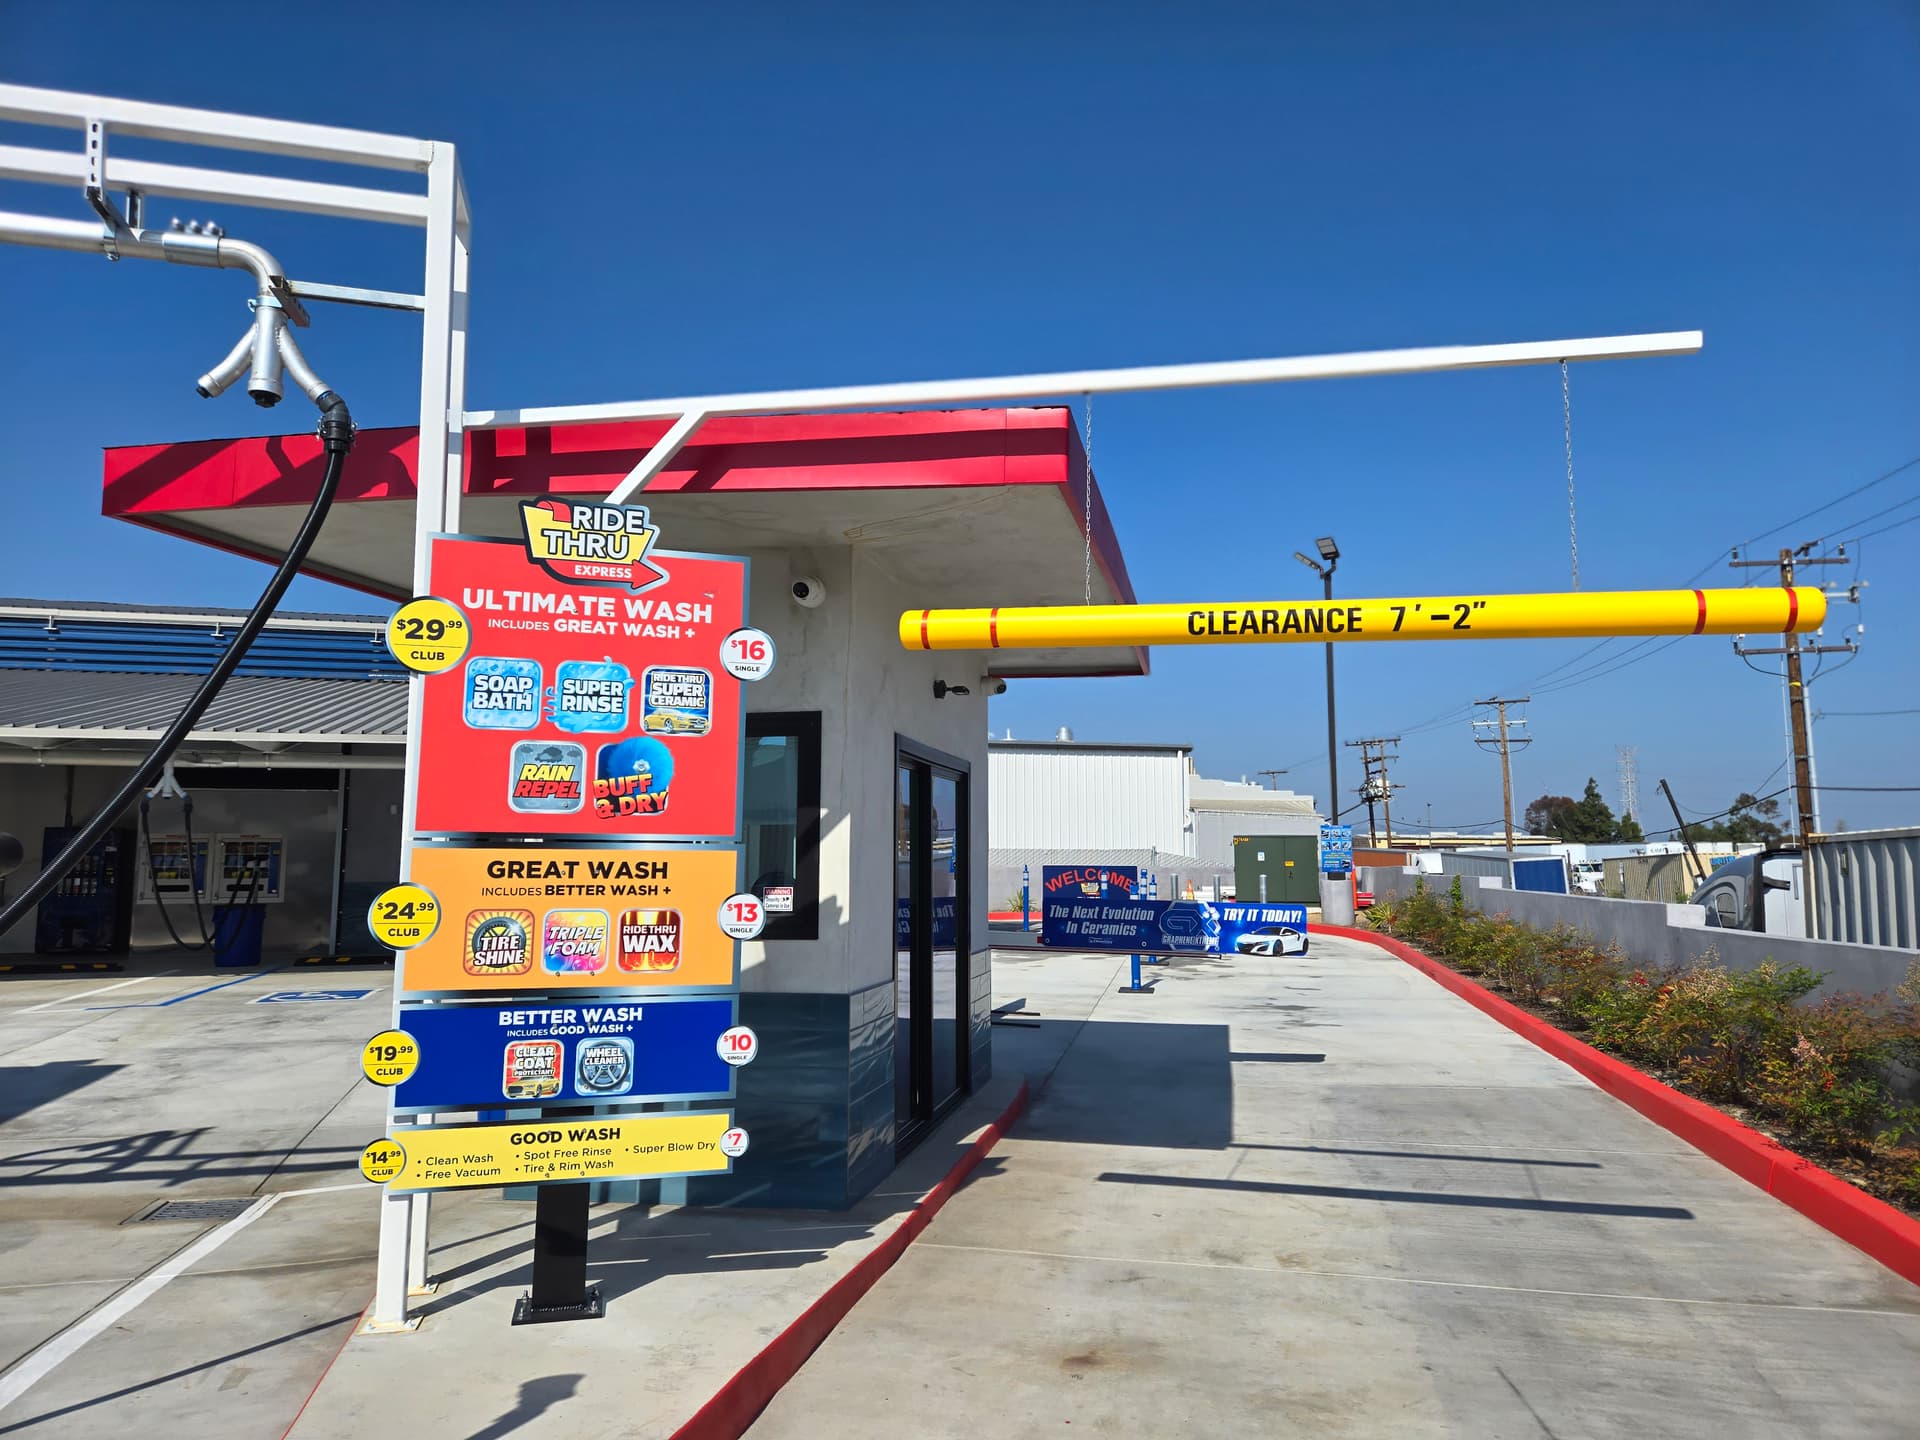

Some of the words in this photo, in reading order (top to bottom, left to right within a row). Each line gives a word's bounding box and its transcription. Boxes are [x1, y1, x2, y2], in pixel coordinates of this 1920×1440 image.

[572, 506, 644, 534] RIDE
[543, 530, 629, 559] THRU
[574, 565, 632, 579] EXPRESS
[463, 588, 616, 617] ULTIMATE
[623, 598, 713, 624] WASH
[488, 618, 550, 632] INCLUDES
[554, 619, 618, 635] GREAT
[622, 623, 680, 639] WASH
[1188, 606, 1363, 636] CLEARANCE
[397, 618, 463, 641] $29.99
[410, 651, 445, 661] CLUB
[731, 639, 766, 660] $16
[474, 674, 533, 693] SOAP
[562, 678, 624, 696] SUPER
[652, 682, 703, 697] SUPER
[473, 692, 533, 711] BATH
[561, 695, 624, 713] RINSE
[651, 695, 704, 707] CERAMIC
[519, 764, 574, 781] RAIN
[513, 780, 580, 798] REPEL
[592, 774, 652, 799] BUFF
[619, 791, 668, 815] DRY
[487, 860, 580, 879] GREAT
[587, 861, 668, 879] WASH
[481, 887, 542, 896] INCLUDES
[544, 885, 605, 896] BETTER
[610, 885, 658, 896] WASH
[377, 902, 435, 919] $24.99
[727, 903, 758, 922] $13
[1049, 905, 1069, 918] The
[1072, 906, 1099, 919] Next
[1102, 907, 1155, 921] Evolution
[1224, 908, 1245, 921] TRY
[1246, 908, 1261, 922] IT
[1261, 909, 1303, 923] TODAY!
[388, 928, 420, 937] CLUB
[549, 926, 604, 941] TRIPLE
[1066, 921, 1078, 934] In
[1081, 921, 1137, 936] Ceramics
[480, 935, 520, 951] TIRE
[549, 941, 600, 957] FOAM
[622, 934, 676, 953] WAX
[474, 950, 525, 966] SHINE
[499, 1009, 577, 1026] BETTER
[582, 1007, 643, 1023] WASH
[507, 1029, 548, 1037] INCLUDES
[550, 1025, 585, 1036] GOOD
[588, 1024, 623, 1034] WASH
[723, 1034, 752, 1051] $10
[369, 1046, 413, 1061] $19.99
[515, 1046, 554, 1057] CLEAR
[585, 1048, 623, 1057] WHEEL
[515, 1057, 554, 1069] COAT
[584, 1057, 625, 1065] CLEANER
[376, 1068, 403, 1076] CLUB
[513, 1069, 554, 1077] PROTECTANT
[510, 1131, 562, 1145] GOOD
[567, 1127, 621, 1142] WASH
[728, 1133, 742, 1146] $7
[523, 1151, 550, 1161] Spot
[554, 1149, 579, 1158] Free
[582, 1147, 612, 1157] Rinse
[633, 1144, 664, 1154] Super
[668, 1142, 693, 1151] Blow
[697, 1141, 716, 1151] Dry
[366, 1150, 401, 1164] $14.99
[426, 1156, 459, 1166] Clean
[463, 1154, 494, 1164] Wash
[371, 1168, 393, 1176] CLUB
[425, 1170, 451, 1179] Free
[455, 1168, 501, 1178] Vacuum
[524, 1164, 545, 1173] Tire
[548, 1163, 555, 1171] &
[560, 1161, 581, 1170] Rim
[584, 1160, 614, 1169] Wash
